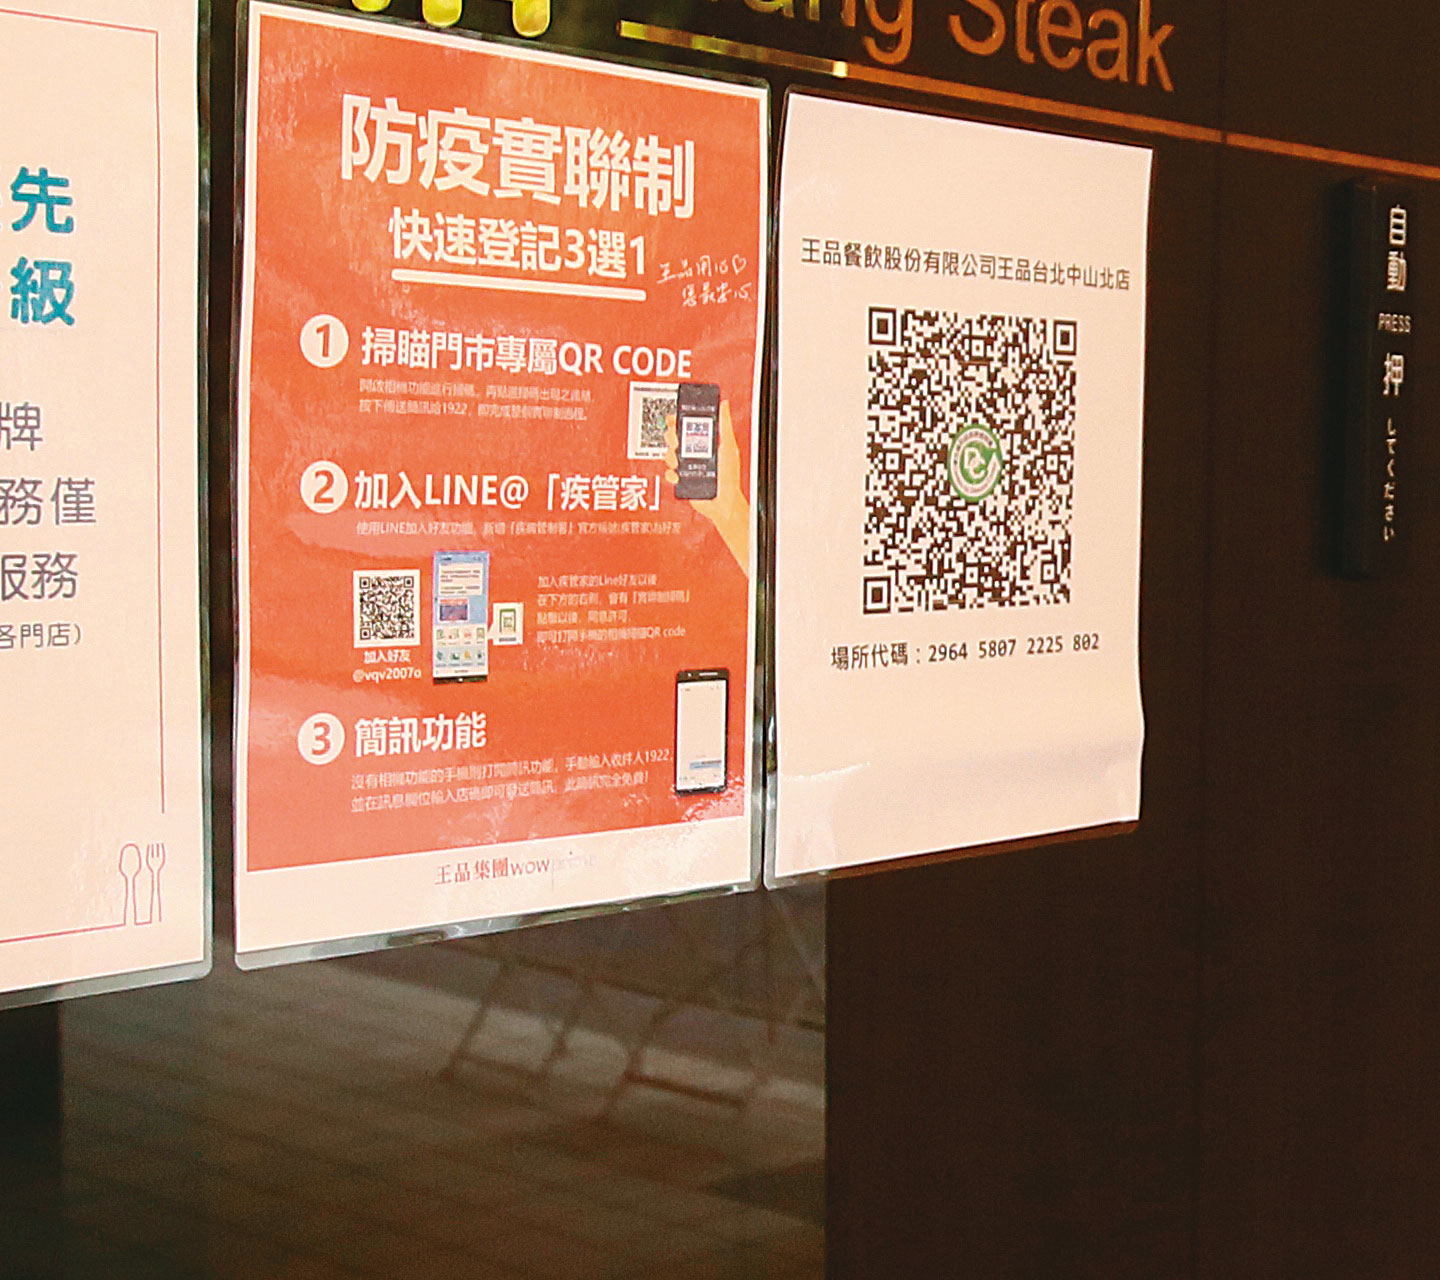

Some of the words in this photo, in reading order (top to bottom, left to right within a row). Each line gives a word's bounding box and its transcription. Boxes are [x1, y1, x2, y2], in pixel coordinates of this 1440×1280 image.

[340, 94, 695, 219] 防疫實聯制
[389, 207, 647, 279] 快速登記3選1
[801, 237, 1130, 291] 王品餐飲股份有限公司王品台北中山北店
[1386, 204, 1408, 292] 自動
[1378, 313, 1411, 333] PRESS
[612, 345, 692, 379] CODE
[364, 649, 411, 664] 加入好友
[978, 639, 1016, 658] 5807
[1026, 636, 1063, 655] 2225
[1073, 633, 1099, 651] 802
[355, 711, 486, 759] 簡訊功能
